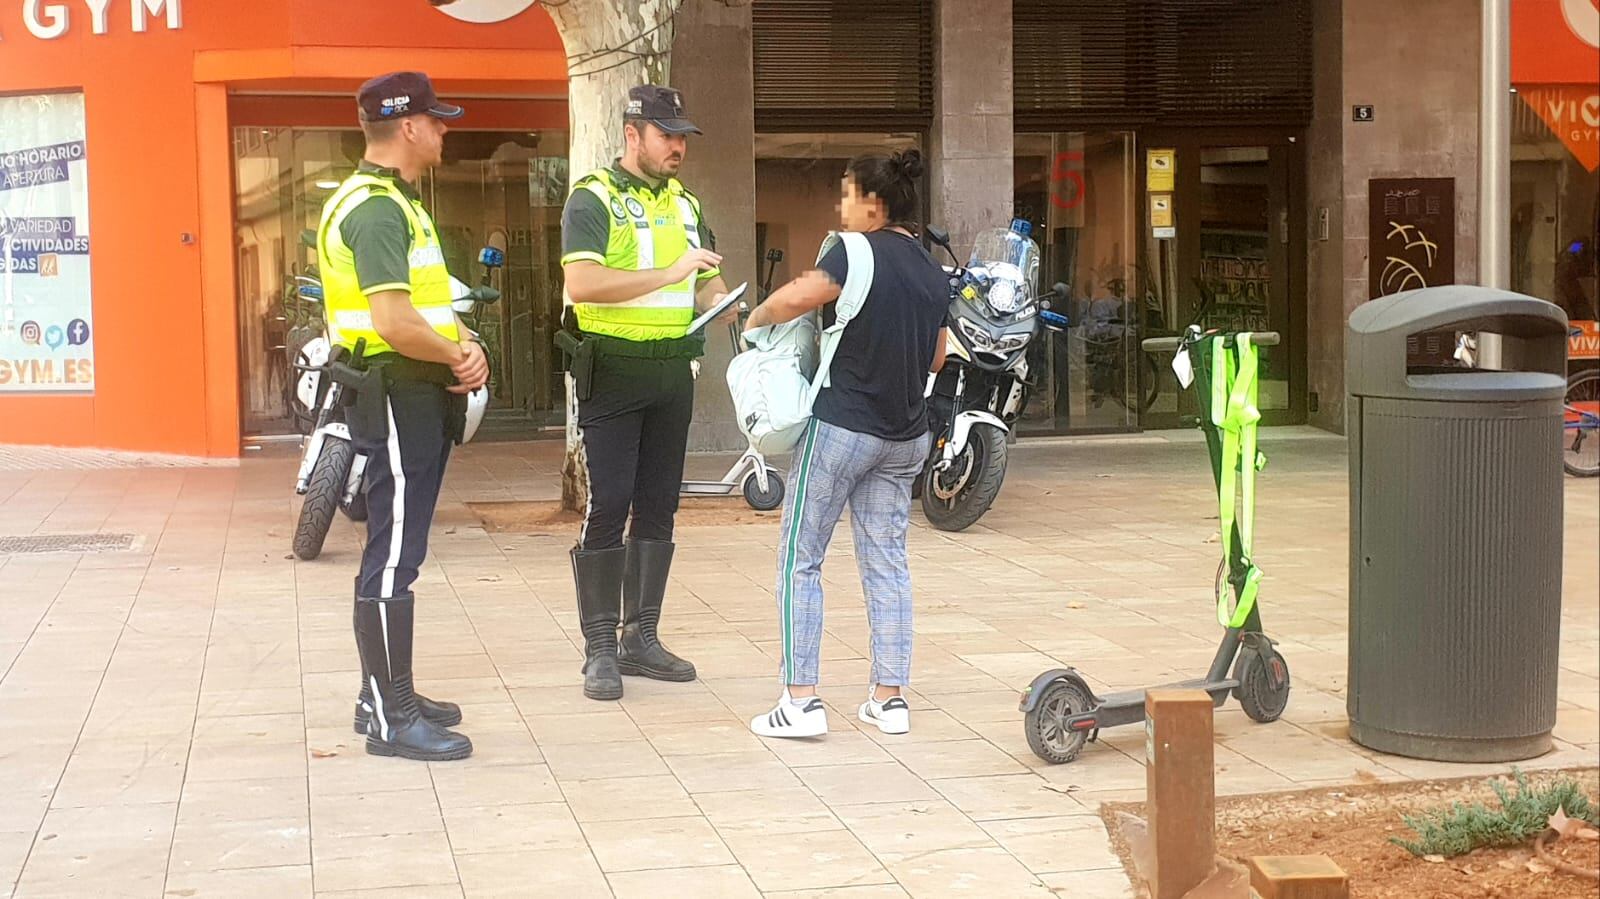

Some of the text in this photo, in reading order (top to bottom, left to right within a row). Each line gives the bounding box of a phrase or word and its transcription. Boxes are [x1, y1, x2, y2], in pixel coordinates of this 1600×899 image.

[22, 0, 183, 39] GYM
[1360, 108, 1367, 118] 5
[19, 144, 82, 166] HORARIO
[4, 165, 65, 188] APERTURA
[1051, 151, 1085, 208] 5
[10, 219, 73, 234] VARIEDAD
[0, 257, 38, 271] GDAS
